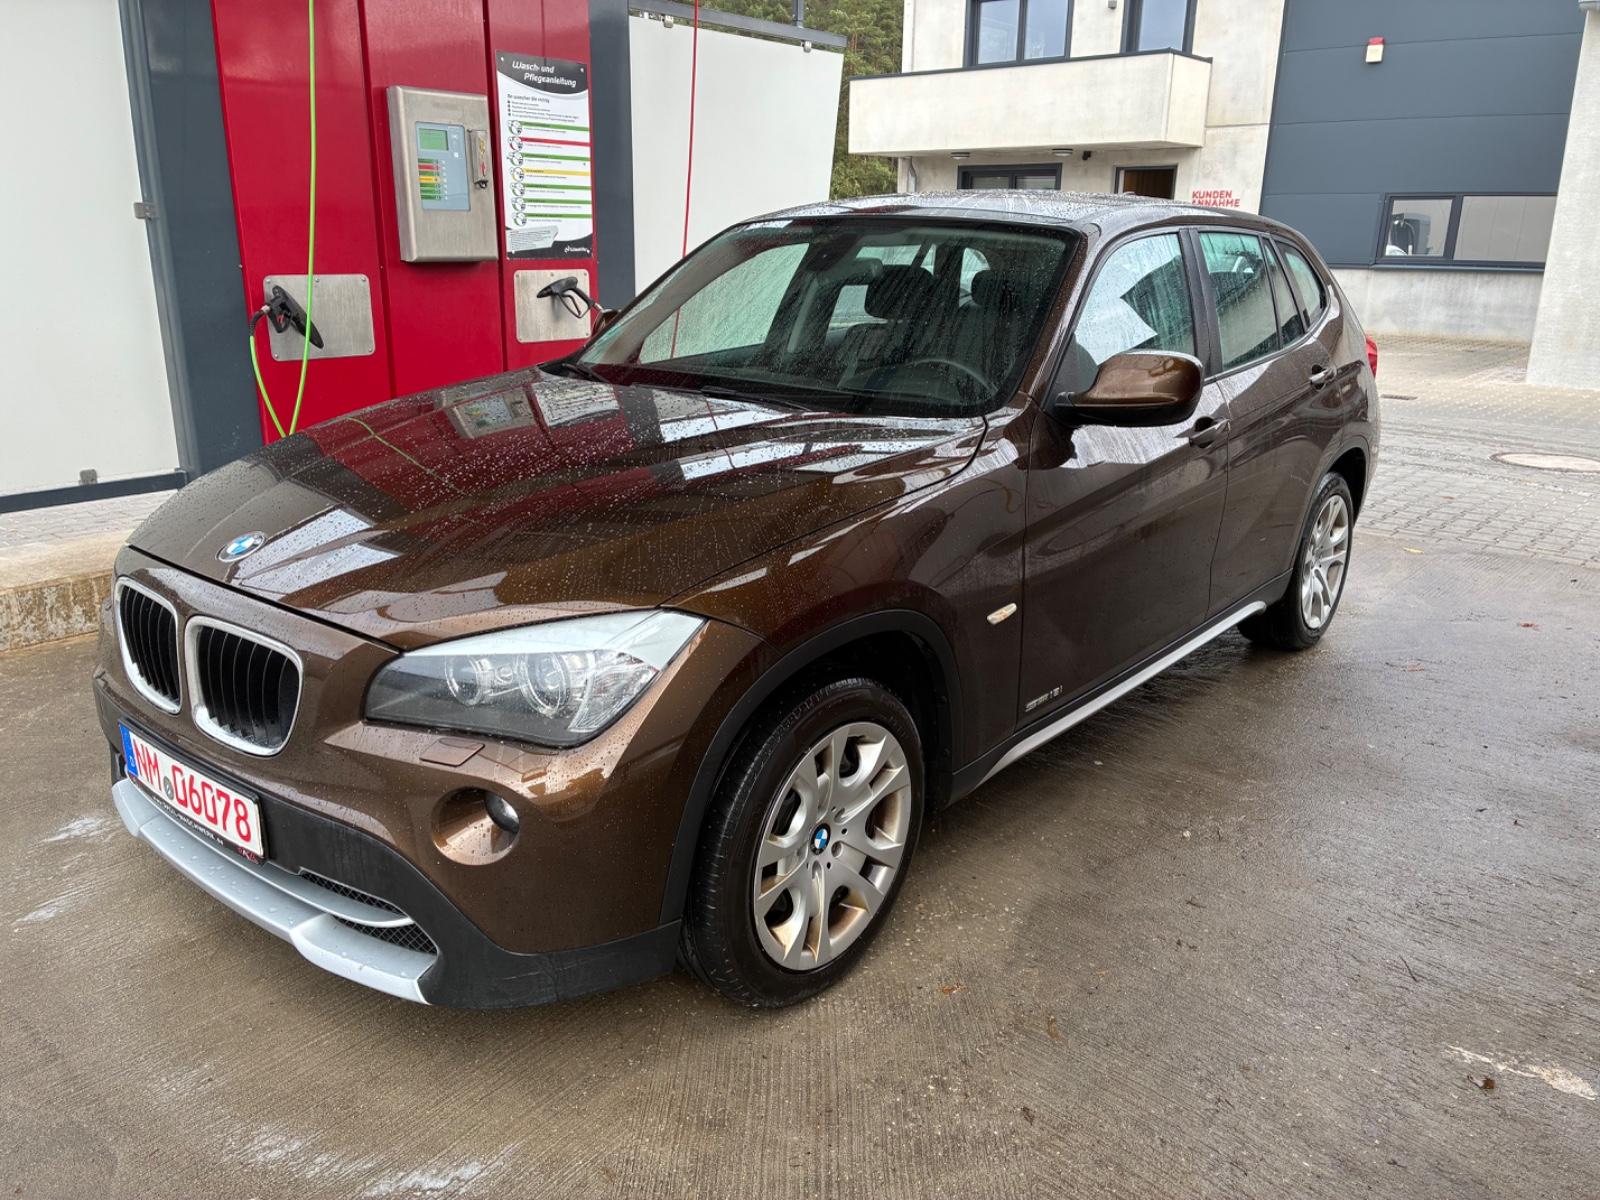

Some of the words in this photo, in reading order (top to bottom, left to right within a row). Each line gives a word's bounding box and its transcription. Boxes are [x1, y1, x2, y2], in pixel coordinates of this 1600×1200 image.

[512, 60, 540, 72] Wasch-
[541, 65, 555, 74] und
[524, 72, 577, 88] Pflegeanleitung
[1191, 190, 1233, 200] KUNDEN
[132, 738, 162, 792] NM
[171, 765, 252, 843] 06078
